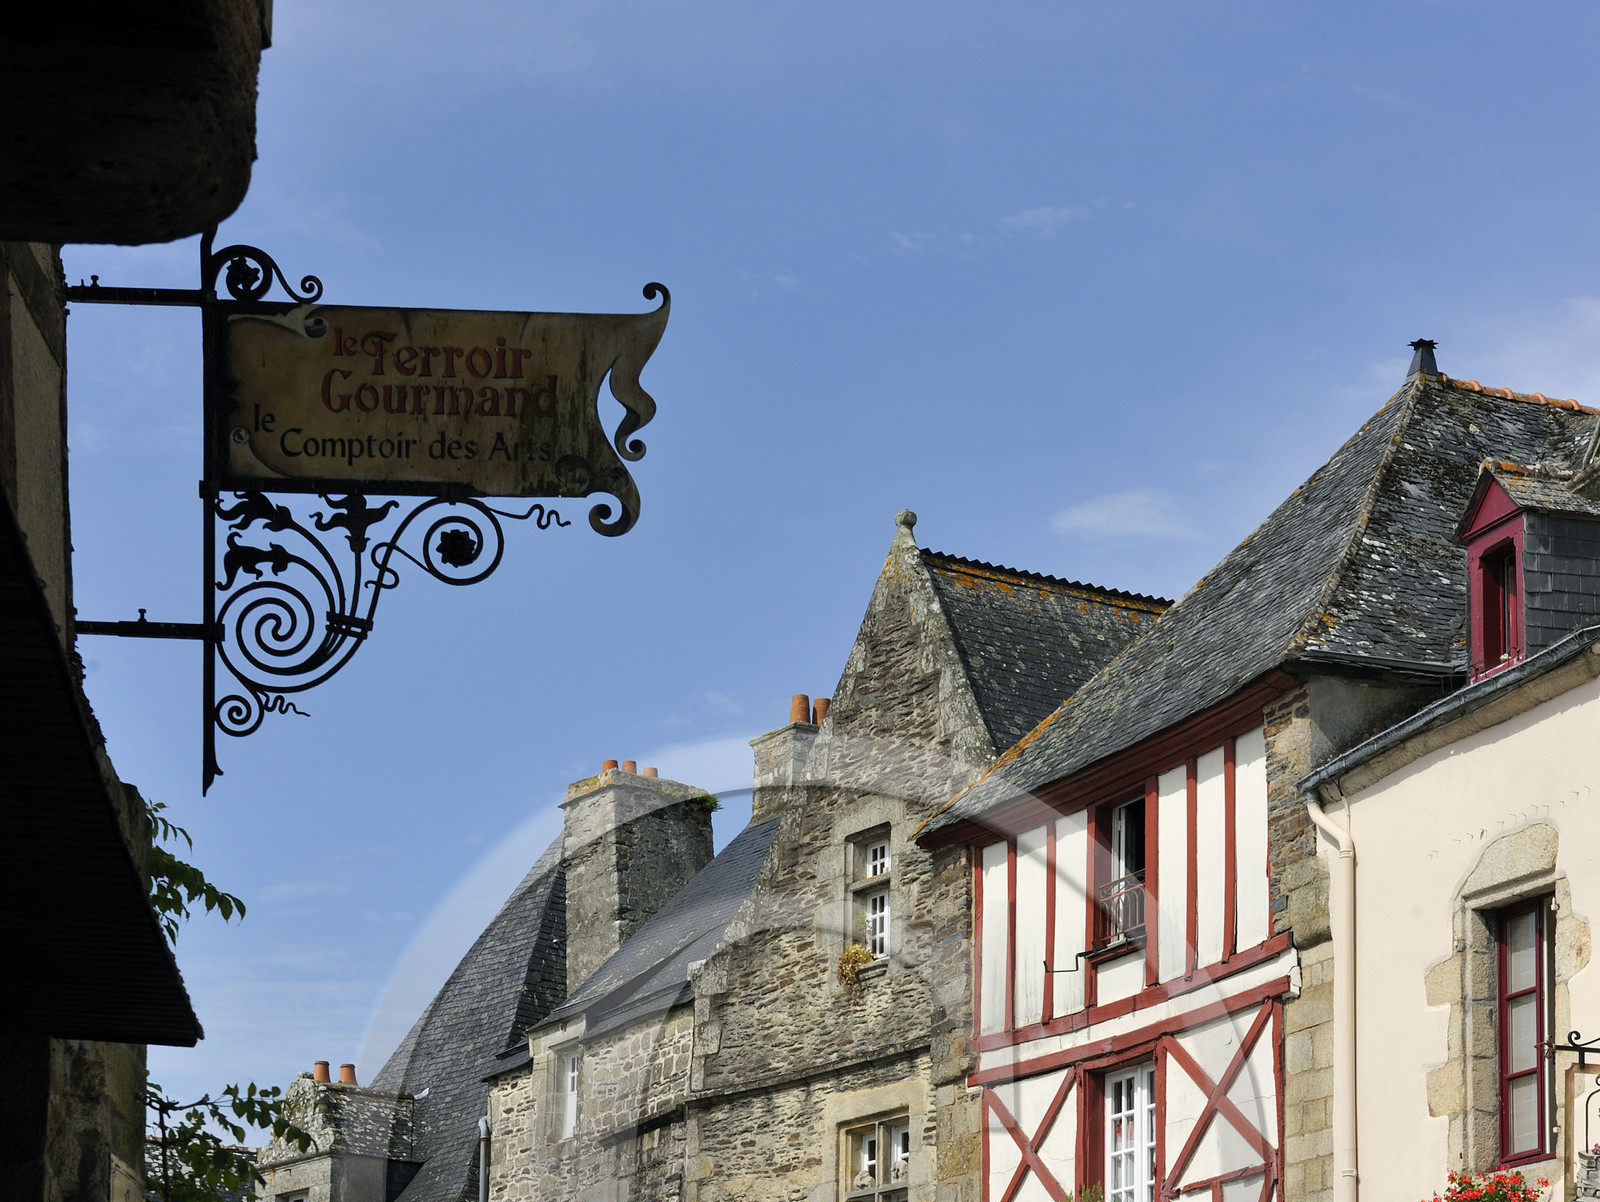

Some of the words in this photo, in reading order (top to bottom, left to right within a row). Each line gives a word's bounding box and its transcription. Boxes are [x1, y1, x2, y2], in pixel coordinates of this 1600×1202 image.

[333, 327, 358, 357] le
[361, 331, 532, 379] Terroir
[321, 368, 559, 420] Gourmand
[253, 403, 276, 433] le
[280, 427, 418, 466] Comptoir
[428, 431, 478, 461] des
[488, 431, 552, 462] Arts
